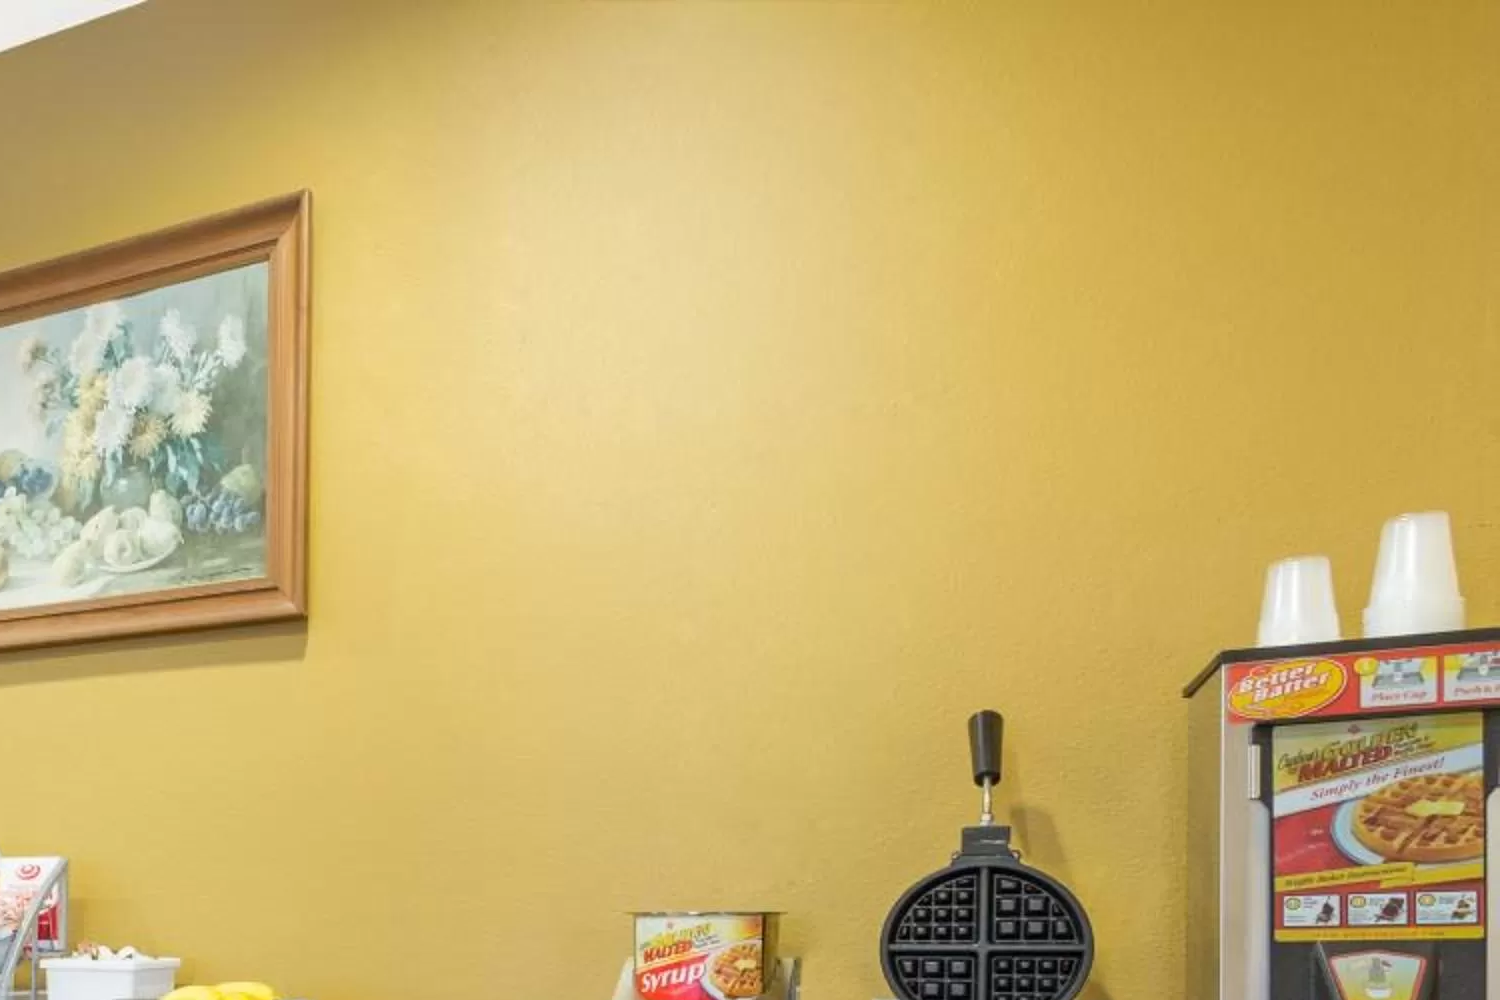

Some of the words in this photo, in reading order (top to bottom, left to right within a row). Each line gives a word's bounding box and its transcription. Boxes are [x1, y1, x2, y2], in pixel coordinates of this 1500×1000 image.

[1240, 663, 1317, 692] Better
[1254, 672, 1330, 702] Batter
[1298, 745, 1394, 781] MALTED
[1310, 778, 1362, 800] Simply
[1365, 773, 1390, 787] the
[1393, 756, 1445, 779] Finest!
[644, 940, 693, 963] MALTED
[640, 962, 704, 993] Syrup
